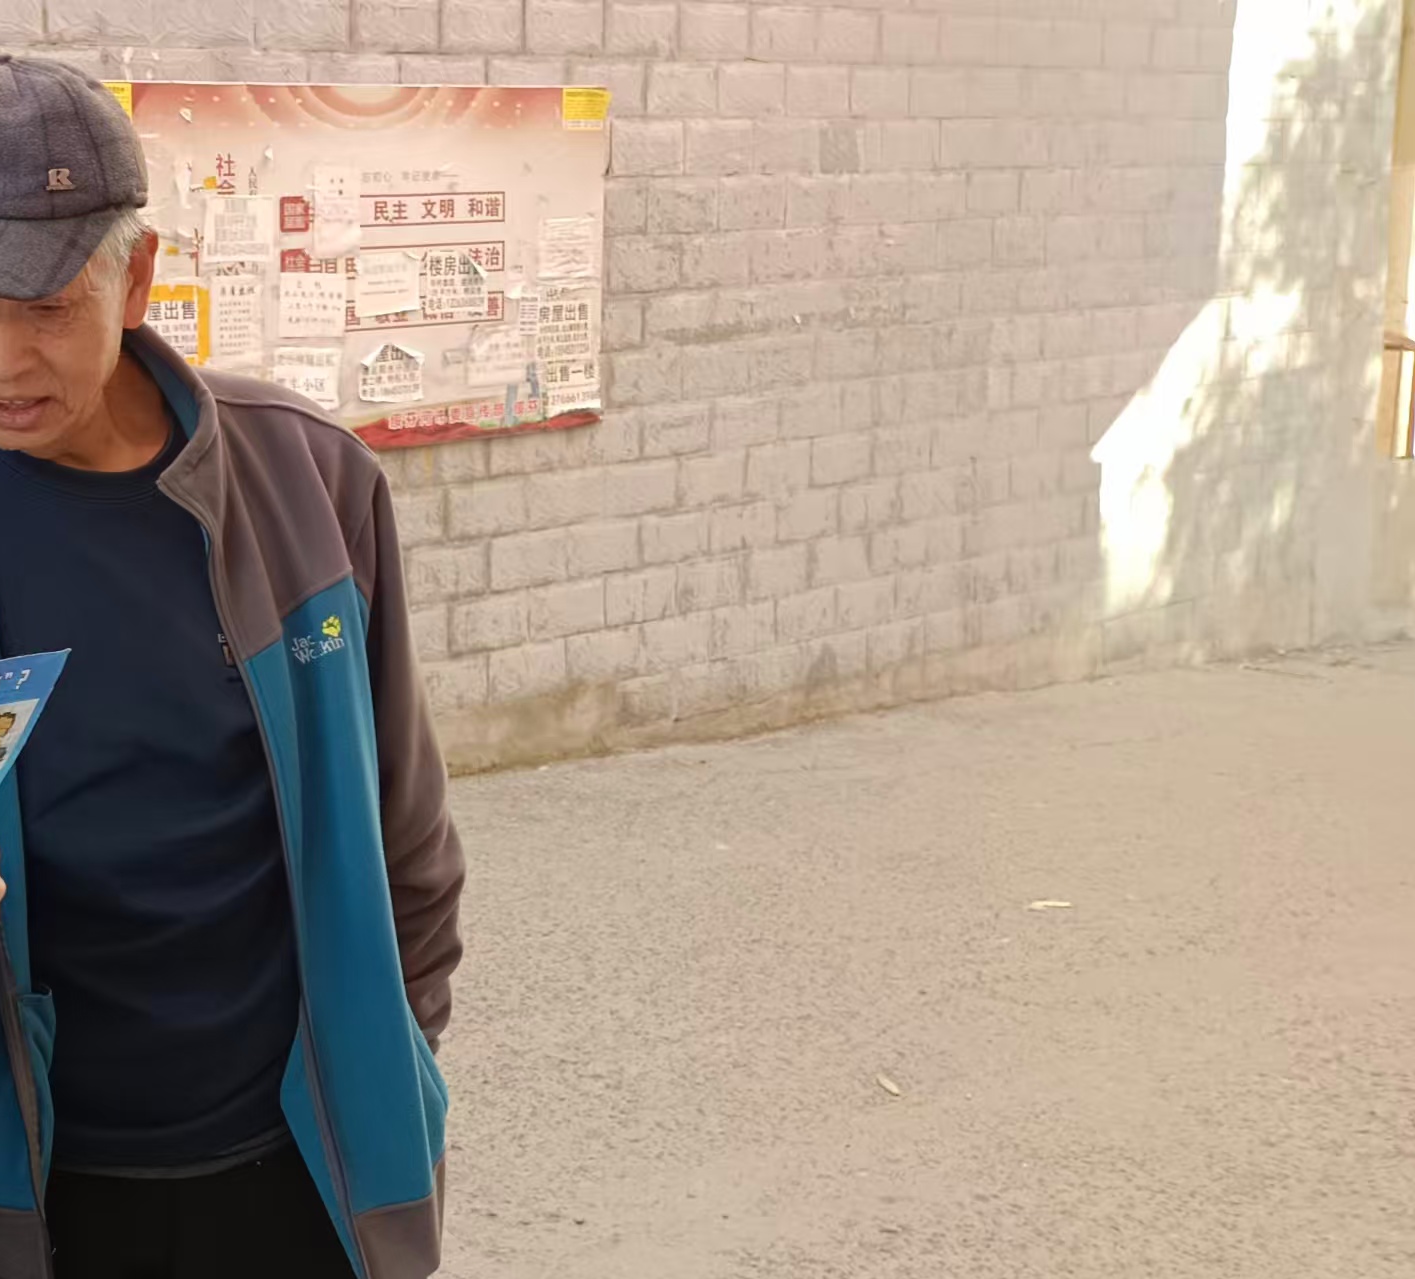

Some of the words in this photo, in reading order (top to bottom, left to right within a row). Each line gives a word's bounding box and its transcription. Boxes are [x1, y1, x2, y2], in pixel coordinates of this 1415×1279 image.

[374, 200, 408, 221] 民主
[421, 198, 454, 219] 文明
[468, 196, 500, 217] 和谐
[429, 255, 481, 277] 楼房出
[148, 302, 196, 321] 屋出售
[539, 303, 589, 324] 房屋出售
